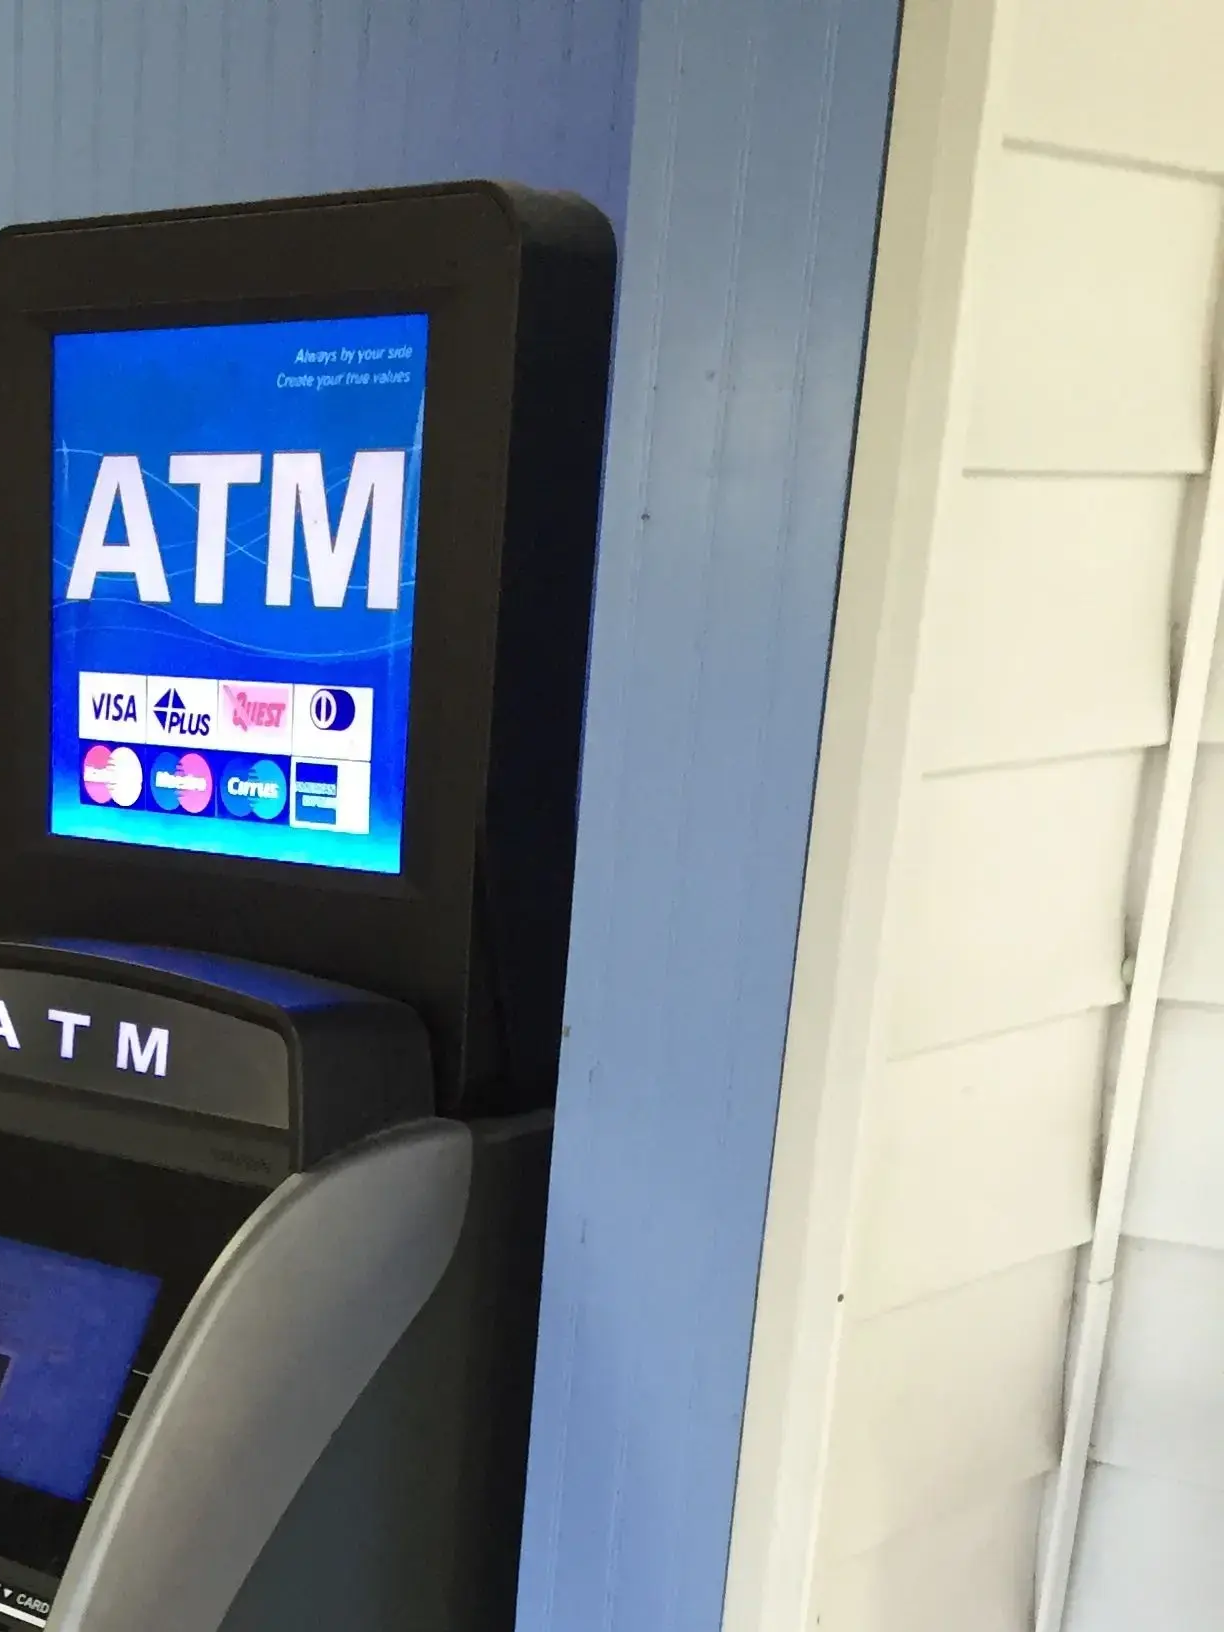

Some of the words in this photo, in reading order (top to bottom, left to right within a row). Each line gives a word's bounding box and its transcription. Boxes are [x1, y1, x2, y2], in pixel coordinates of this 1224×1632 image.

[294, 348, 338, 366] Always
[339, 346, 356, 364] by
[357, 348, 386, 364] your
[387, 344, 413, 359] side
[276, 371, 315, 388] Create
[316, 373, 344, 391] your
[345, 371, 371, 385] true
[373, 369, 411, 384] values
[66, 450, 407, 612] ATM
[92, 693, 137, 723] VISA
[167, 711, 211, 737] PLUS
[16, 1593, 50, 1614] CARD
